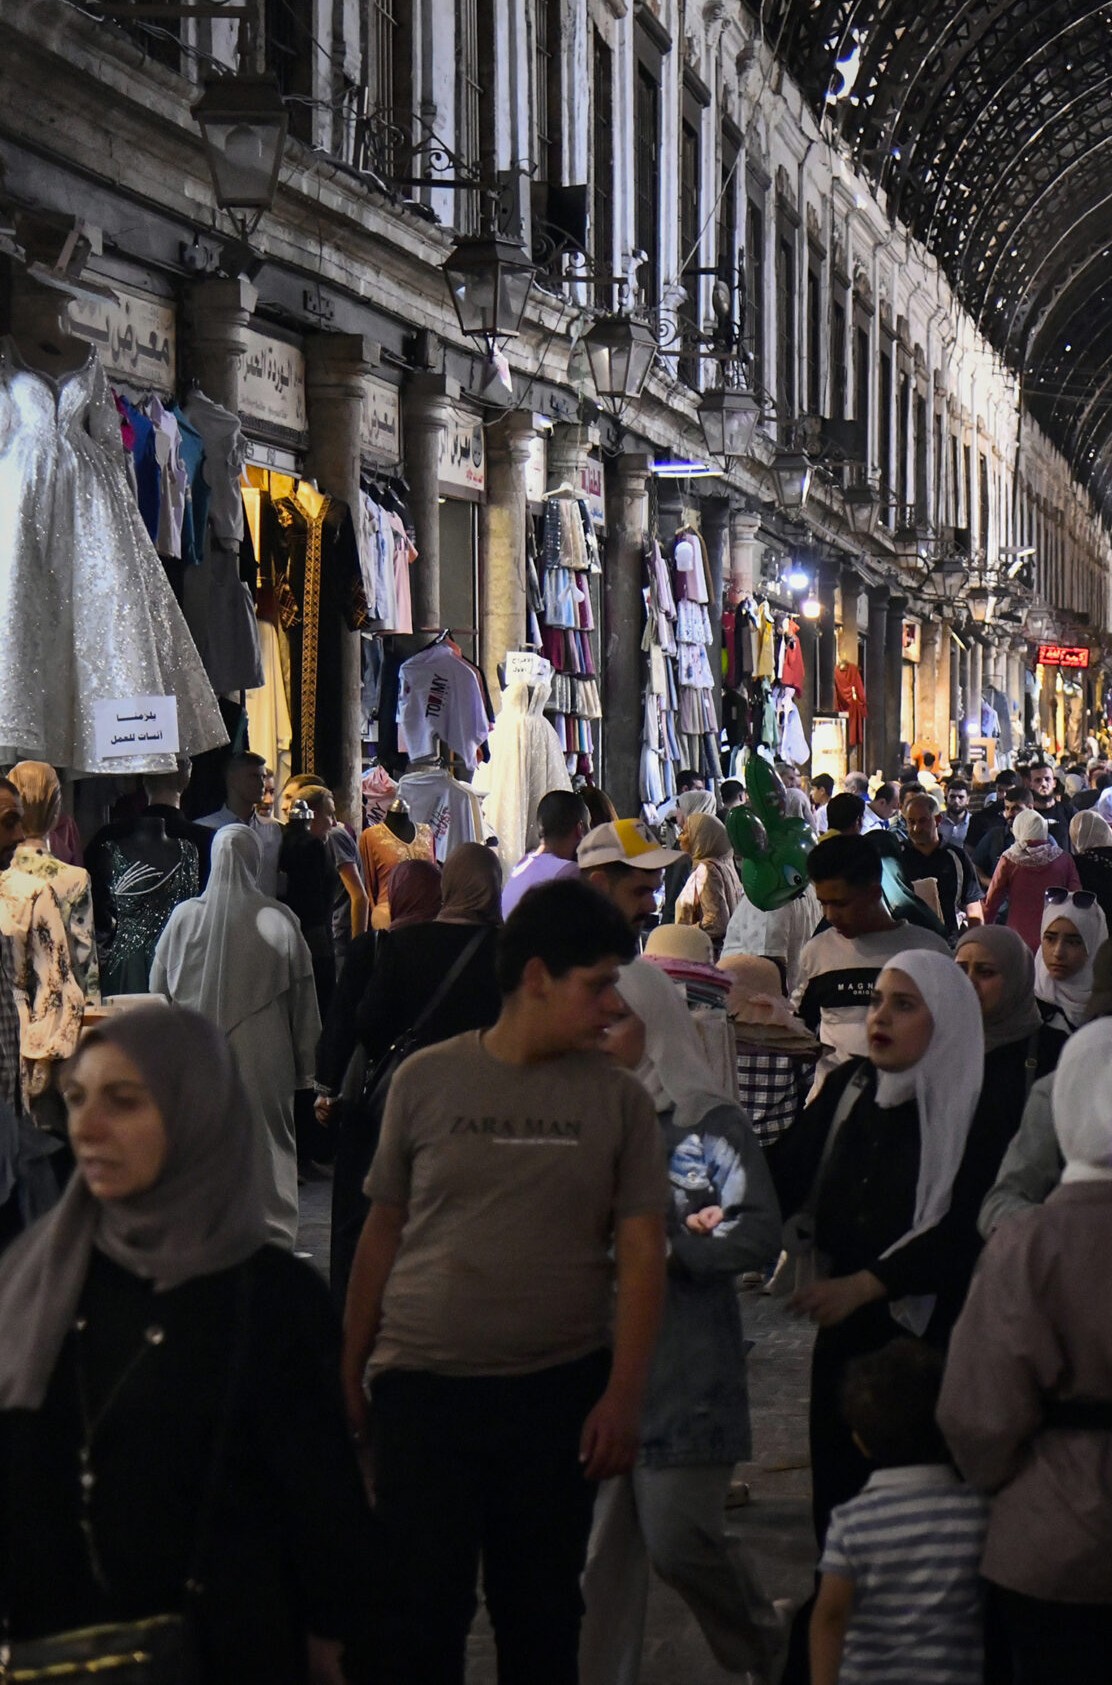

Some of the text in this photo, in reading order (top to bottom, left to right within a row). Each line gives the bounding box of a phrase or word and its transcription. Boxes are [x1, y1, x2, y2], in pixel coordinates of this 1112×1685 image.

[111, 733, 135, 745] للعمل
[838, 982, 874, 991] MAGN
[450, 1116, 581, 1137] ZARA MAN
